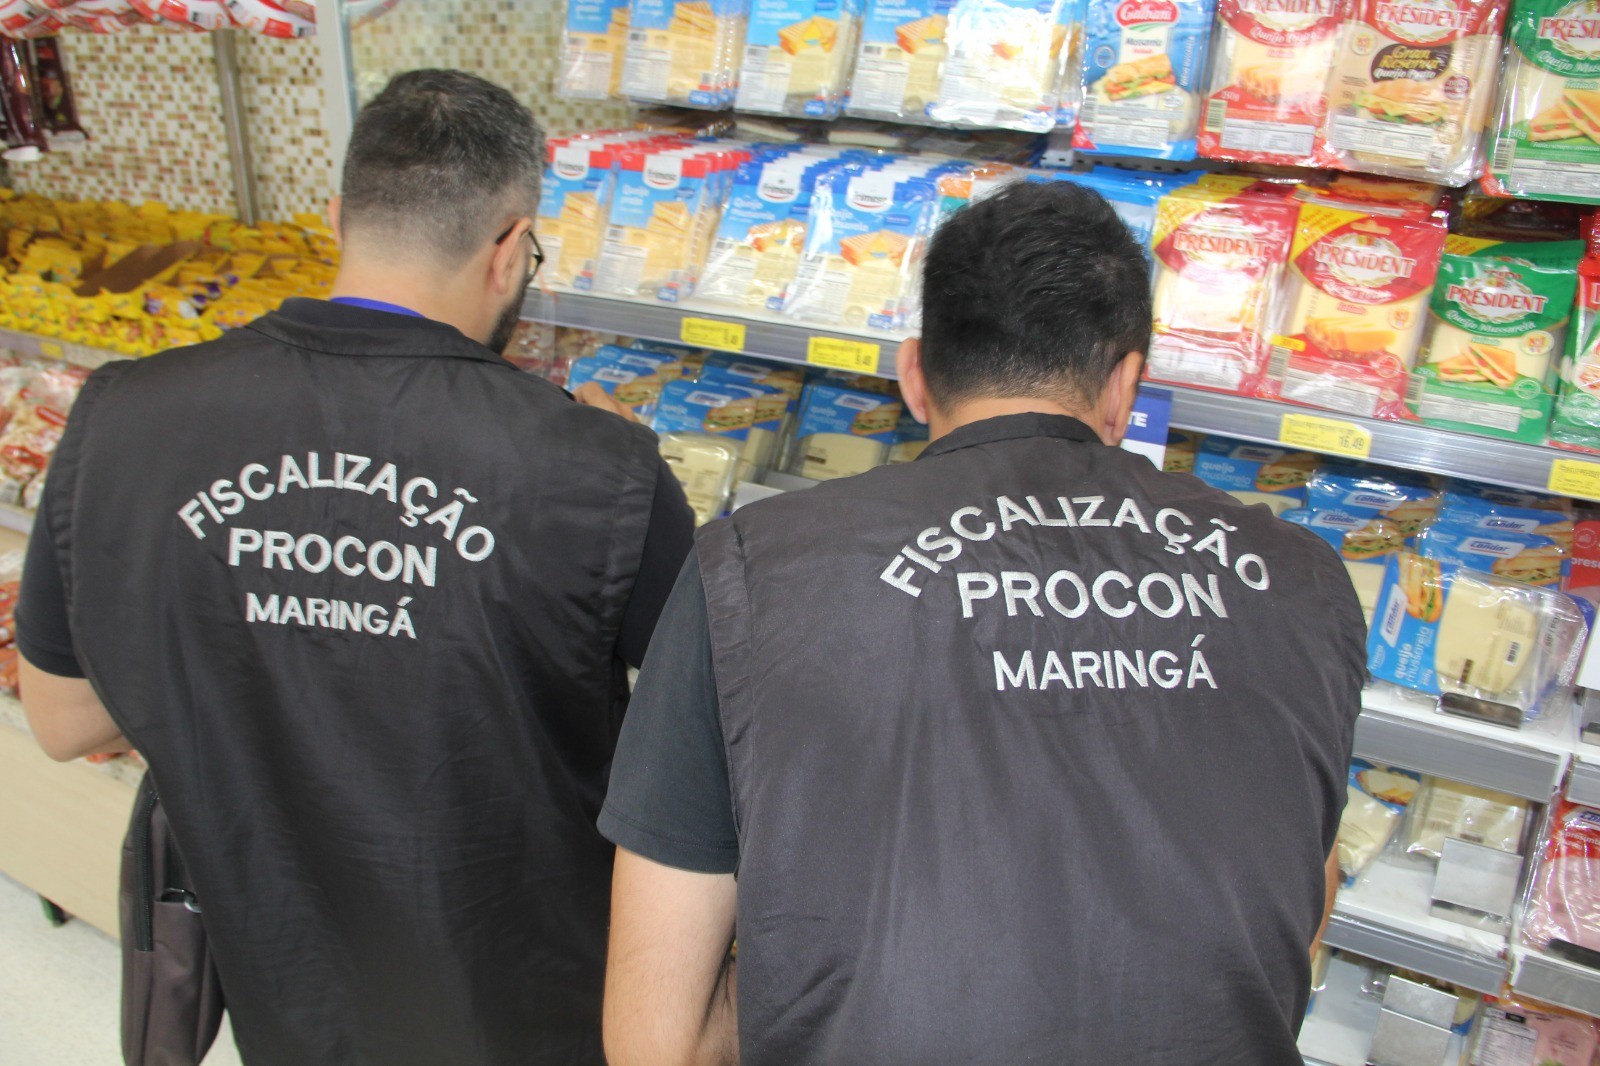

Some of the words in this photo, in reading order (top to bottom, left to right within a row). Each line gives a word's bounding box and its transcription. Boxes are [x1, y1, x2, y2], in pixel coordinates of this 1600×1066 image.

[1201, 462, 1236, 474] queijo
[177, 451, 496, 562] FISCALIZAÇÃO
[1486, 519, 1526, 531] Condor
[228, 527, 438, 587] PROCON
[879, 495, 1270, 598] FISCALIZAÇÃO
[1469, 538, 1511, 553] Condor
[246, 592, 418, 640] MARINGÁ
[956, 569, 1229, 619] PROCON
[993, 633, 1218, 691] MARINGÁ
[1394, 643, 1413, 680] queijo
